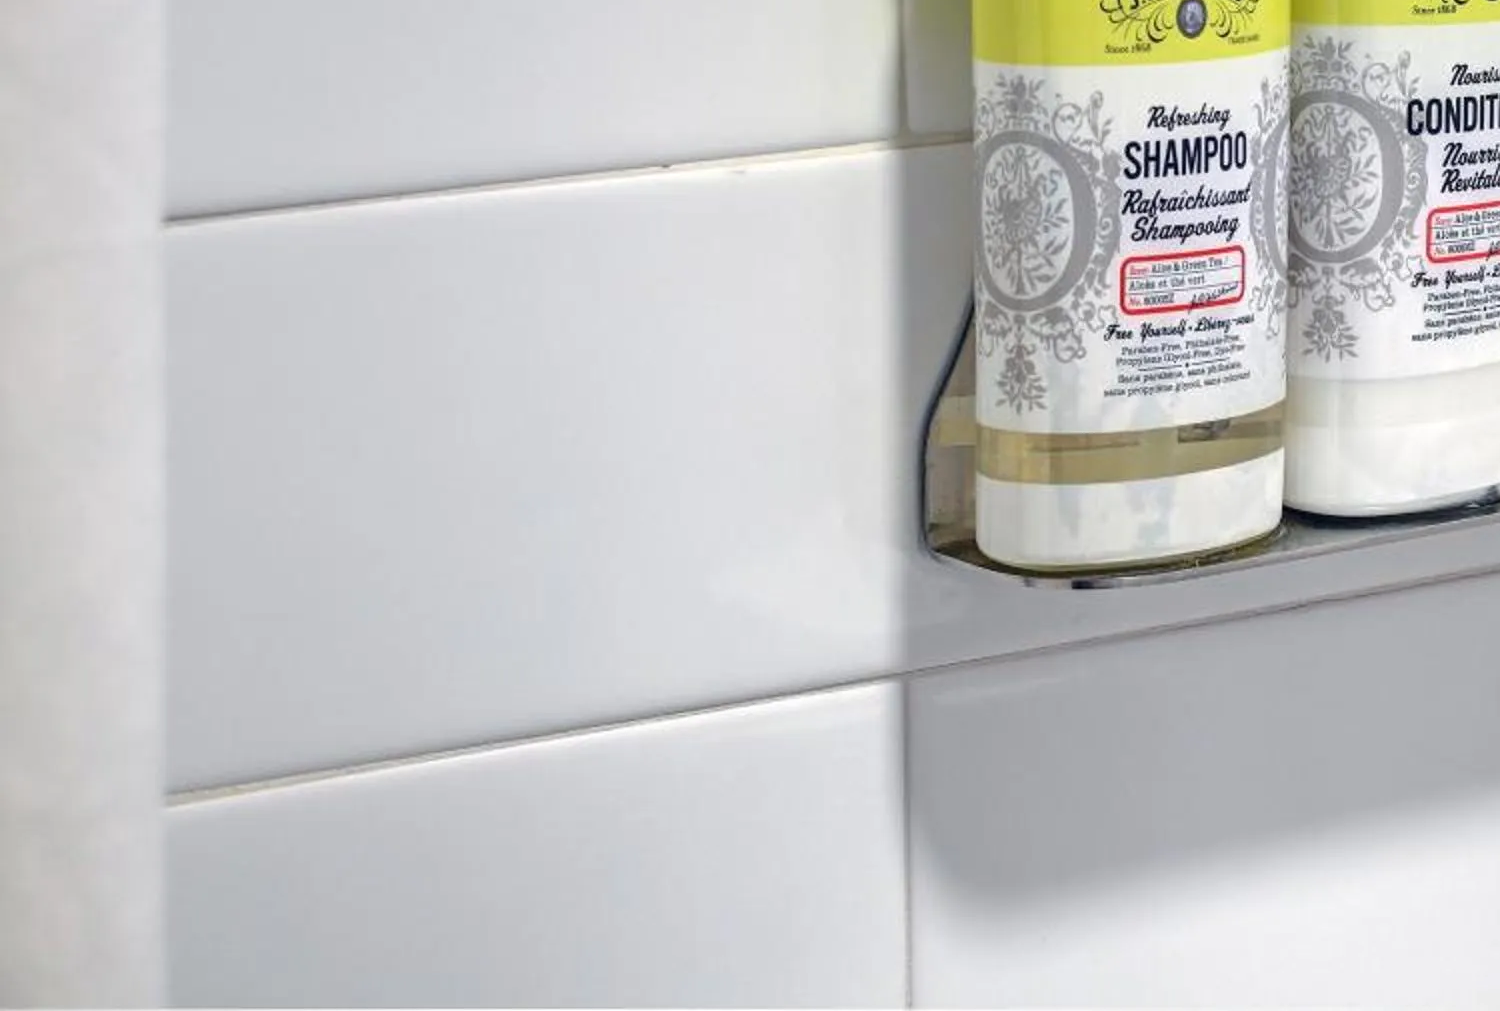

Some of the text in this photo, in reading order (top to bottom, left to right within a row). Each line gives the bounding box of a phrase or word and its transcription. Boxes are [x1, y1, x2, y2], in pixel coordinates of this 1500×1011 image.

[1147, 102, 1232, 131] Refreshing
[1123, 131, 1248, 180] SHAMPOO
[1122, 181, 1252, 217] Rafraîchissant
[1131, 215, 1239, 245] Shampooing
[1410, 272, 1438, 288] Free
[1104, 324, 1133, 341] Free
